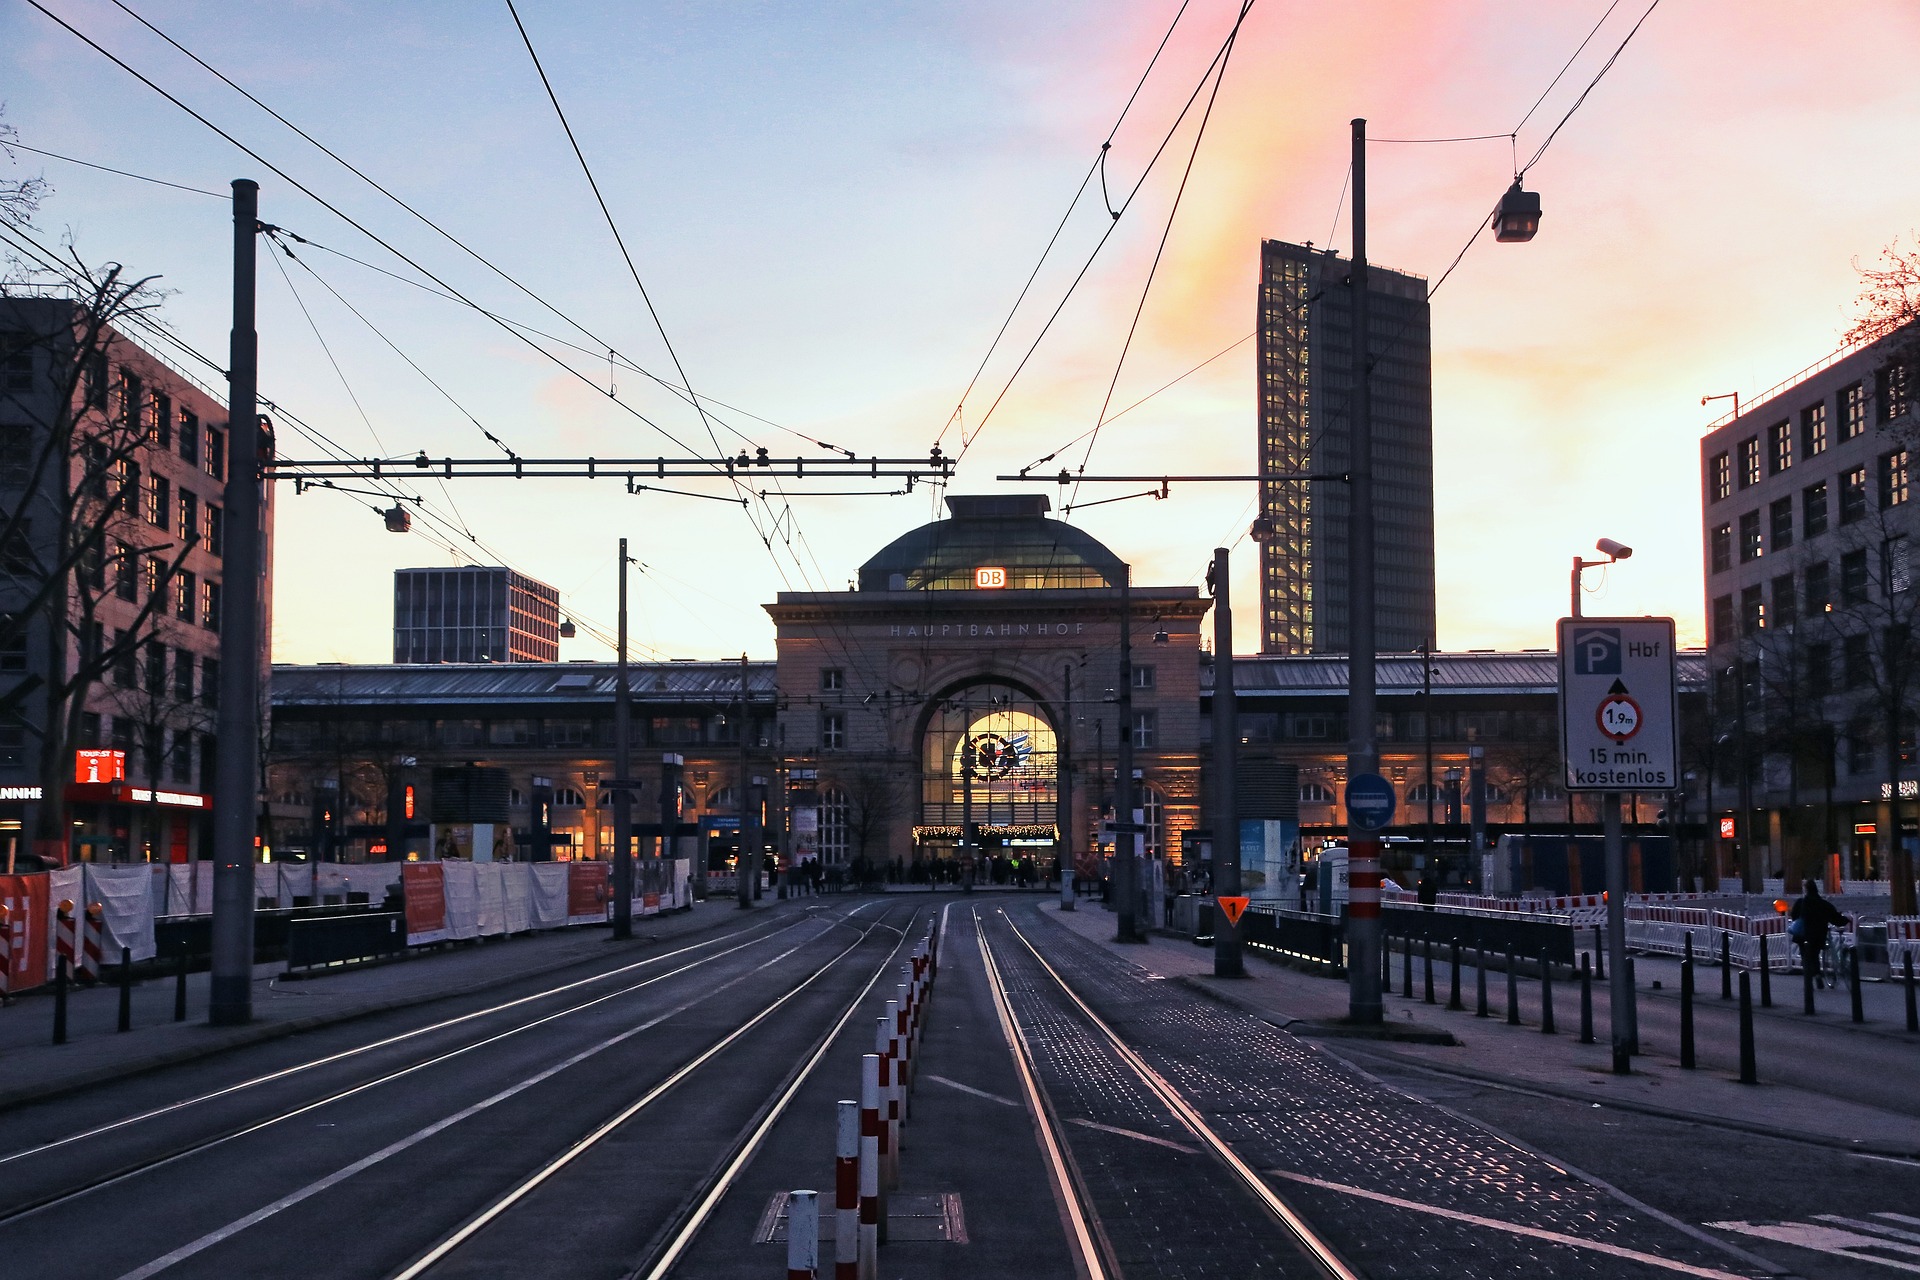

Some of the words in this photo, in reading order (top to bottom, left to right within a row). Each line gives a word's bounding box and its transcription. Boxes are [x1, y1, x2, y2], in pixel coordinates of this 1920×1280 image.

[980, 571, 1002, 585] DB
[891, 623, 1084, 637] HAUPTBAHNHOF
[1629, 642, 1660, 657] Hbf
[1589, 749, 1607, 764] 15
[1614, 749, 1652, 765] min.
[1576, 767, 1666, 784] kostenlos
[0, 787, 43, 800] NNHE
[1229, 902, 1237, 917] 1
